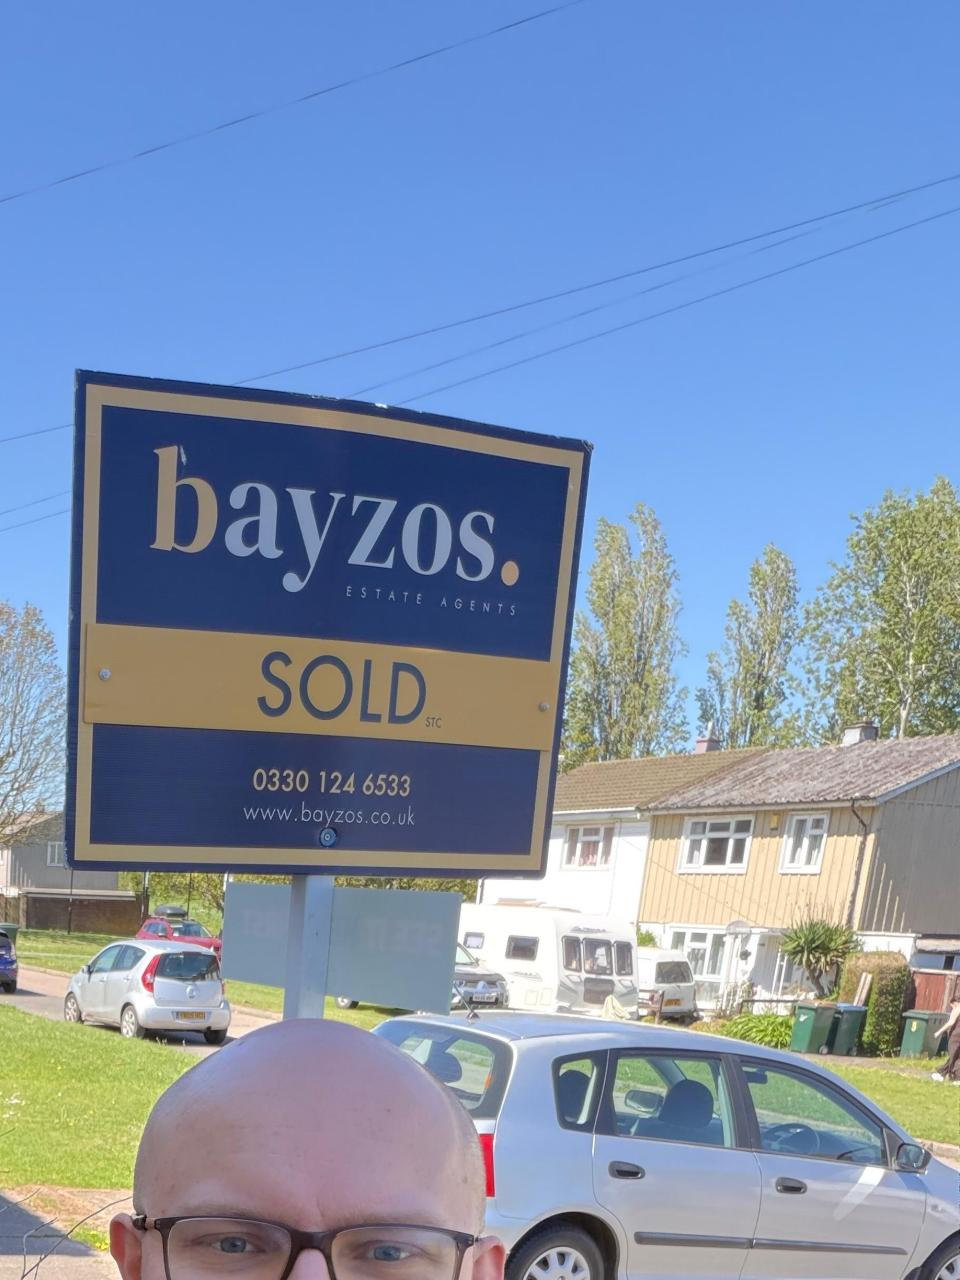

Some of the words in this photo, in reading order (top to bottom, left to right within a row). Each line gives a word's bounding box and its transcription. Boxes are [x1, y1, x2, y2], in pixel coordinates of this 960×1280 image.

[150, 445, 520, 592] bayzos.
[346, 585, 422, 605] ESTATE
[440, 597, 516, 616] AGENTS
[257, 651, 427, 725] SOLD
[425, 716, 442, 729] STC
[252, 768, 309, 793] 0330
[319, 771, 355, 794] 124
[362, 773, 411, 797] 6533
[243, 801, 415, 828] www.bayzos.co.uk
